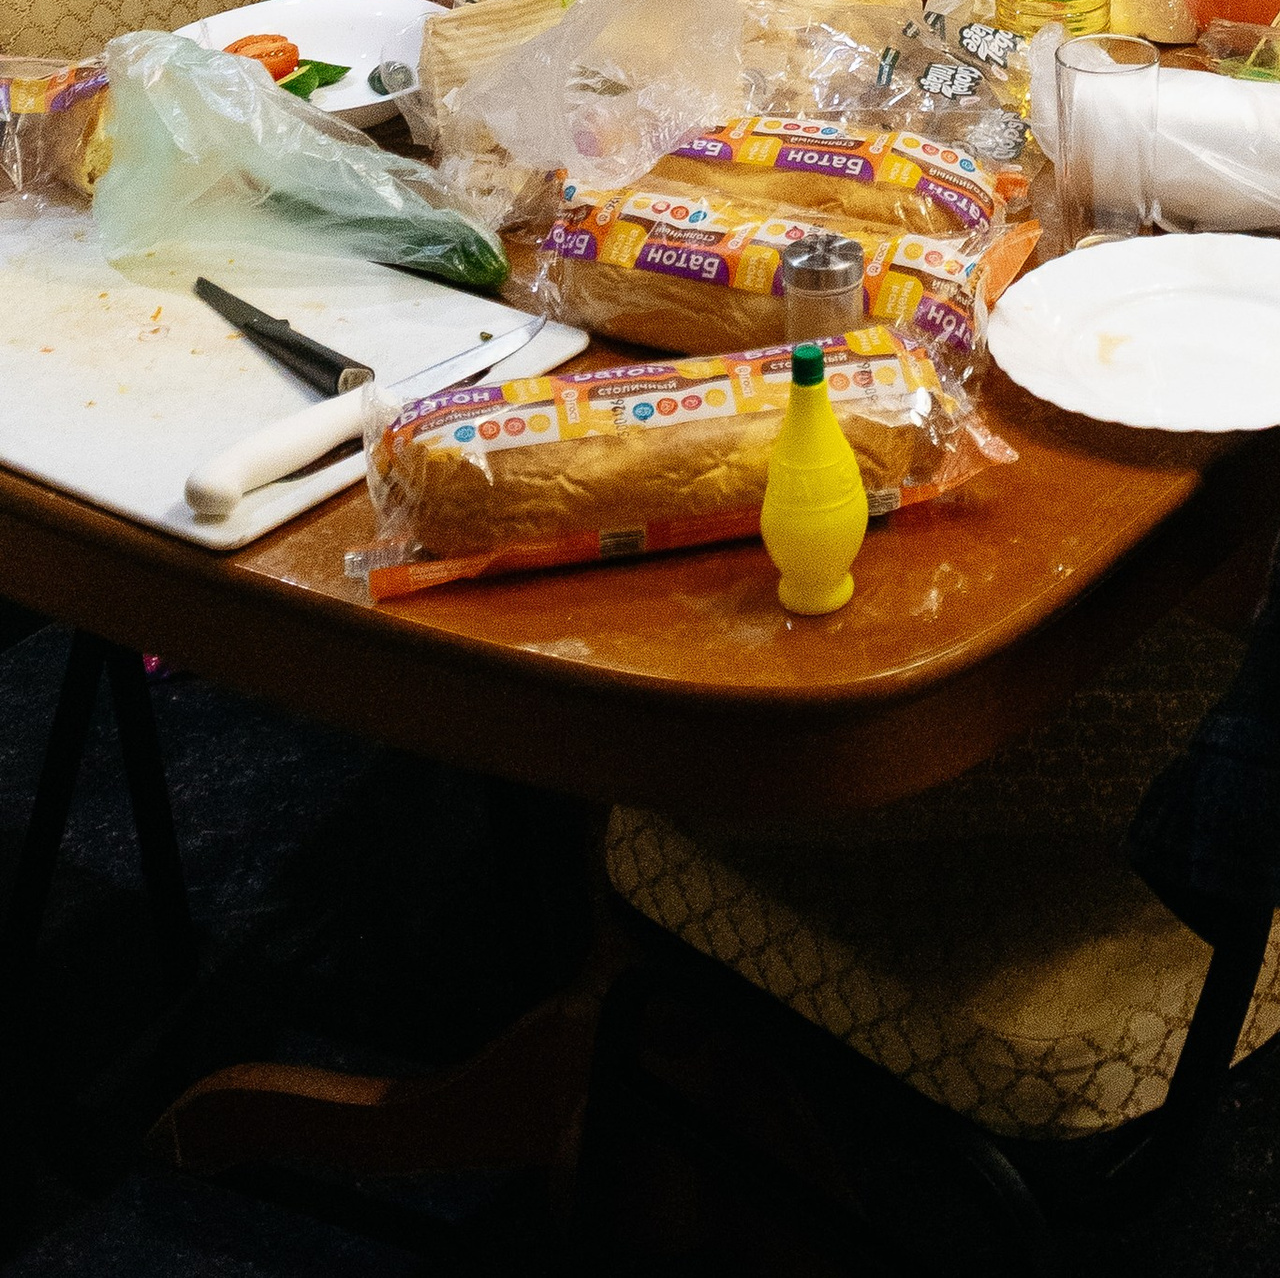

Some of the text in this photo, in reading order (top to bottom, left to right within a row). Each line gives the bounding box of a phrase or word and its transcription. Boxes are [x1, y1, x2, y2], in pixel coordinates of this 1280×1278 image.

[790, 136, 855, 149] столичный
[787, 150, 864, 175] Батон
[646, 245, 721, 279] Батон
[597, 380, 677, 397] столичный
